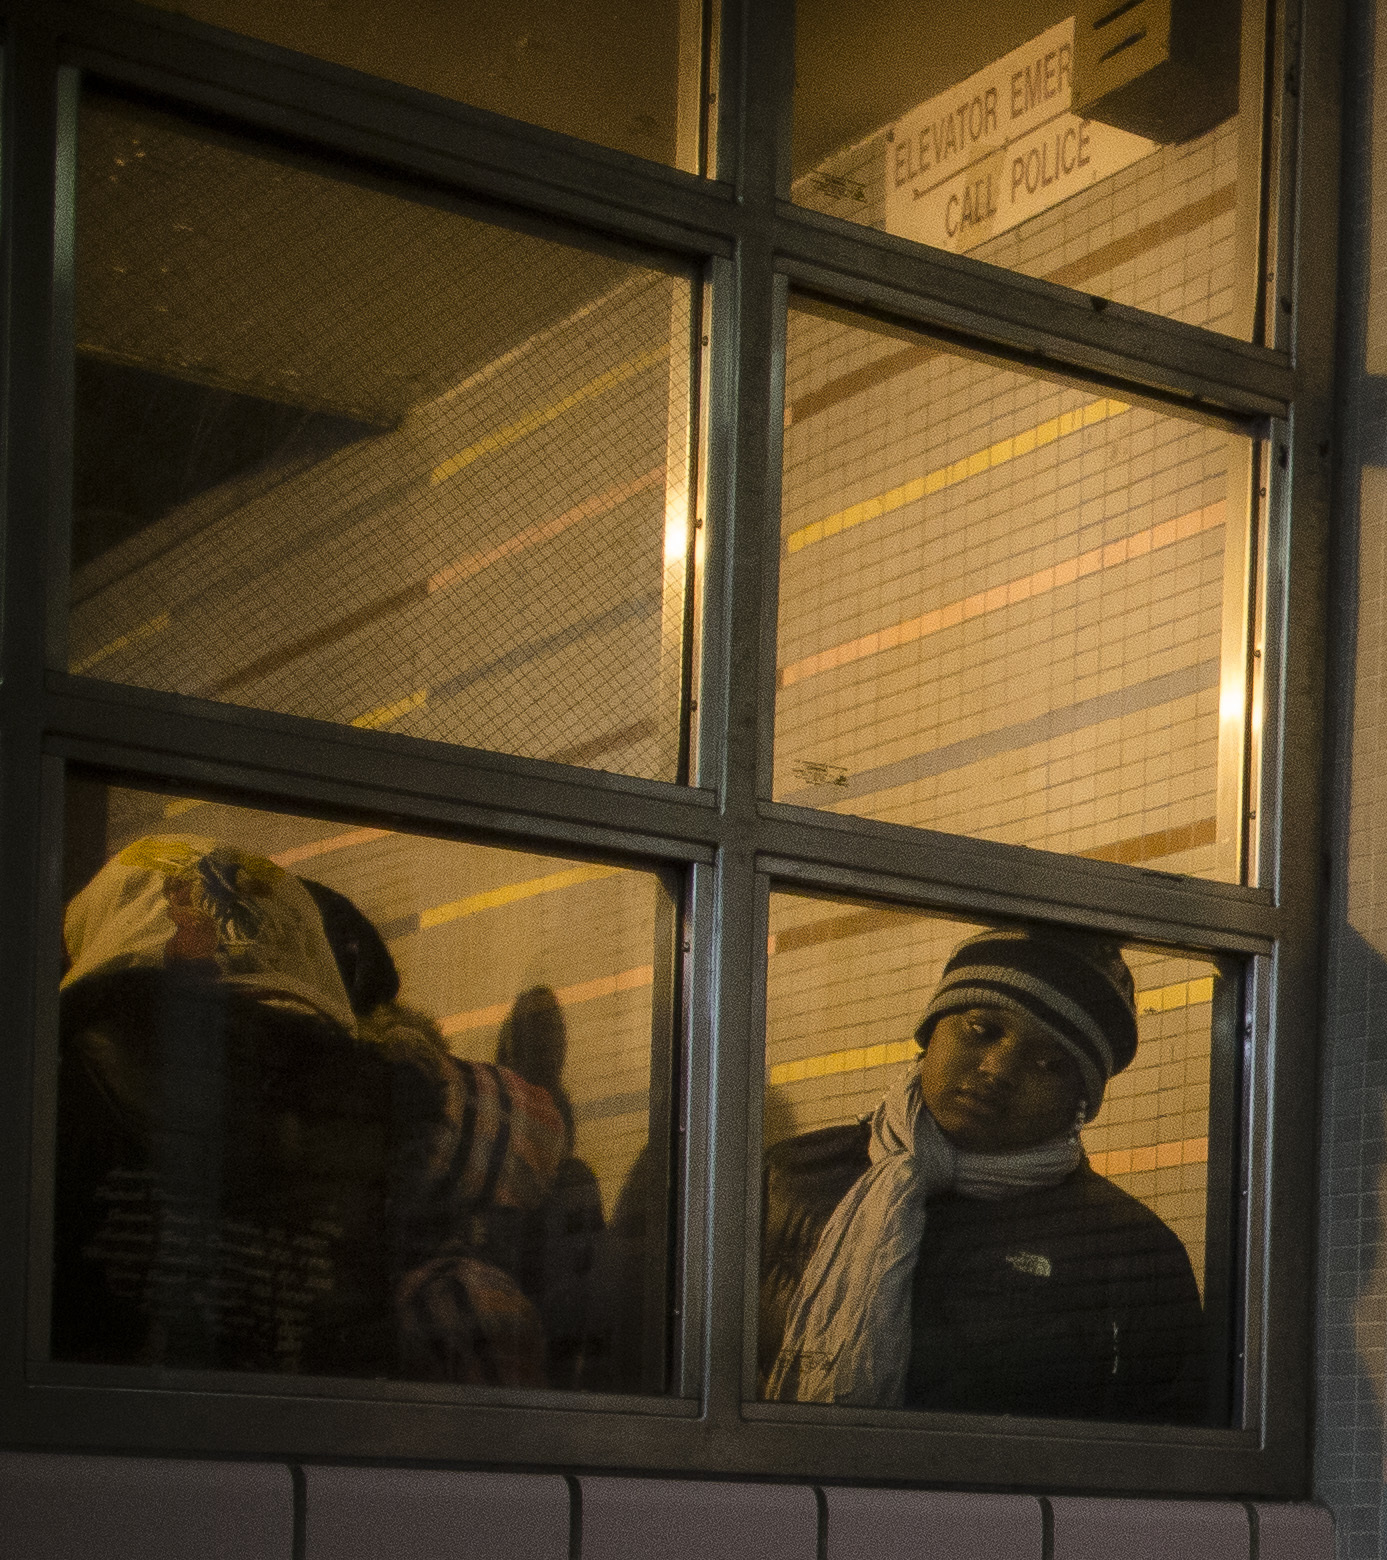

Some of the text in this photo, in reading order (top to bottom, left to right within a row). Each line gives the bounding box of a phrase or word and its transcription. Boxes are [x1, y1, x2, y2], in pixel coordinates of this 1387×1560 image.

[893, 87, 998, 188] ELEVATOR
[944, 120, 1092, 238] CALL POLICE
